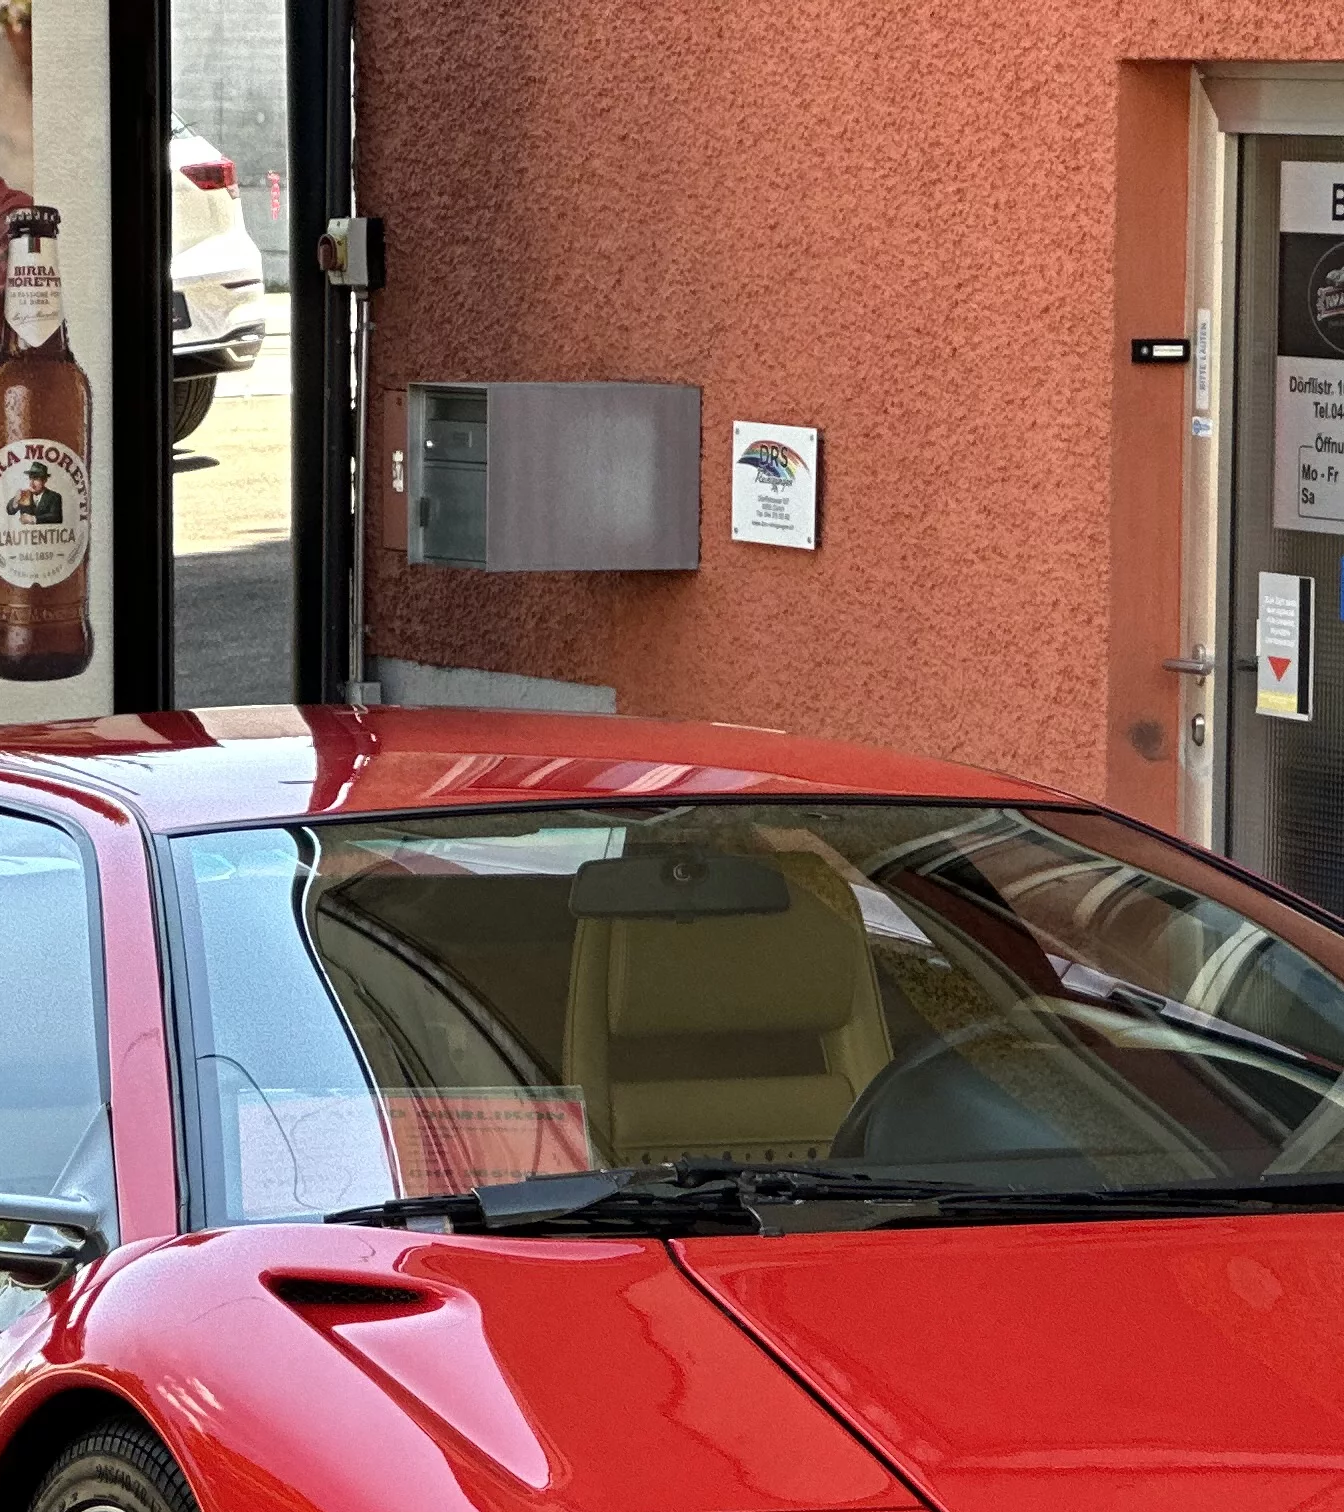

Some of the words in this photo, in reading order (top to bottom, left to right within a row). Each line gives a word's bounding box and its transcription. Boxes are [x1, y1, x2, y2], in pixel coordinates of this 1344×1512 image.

[14, 266, 55, 276] BIRRA
[760, 444, 788, 468] DRS
[25, 444, 89, 522] MORETTI
[1302, 464, 1318, 481] Mo
[1327, 466, 1339, 483] Fr
[1301, 488, 1315, 505] Sa
